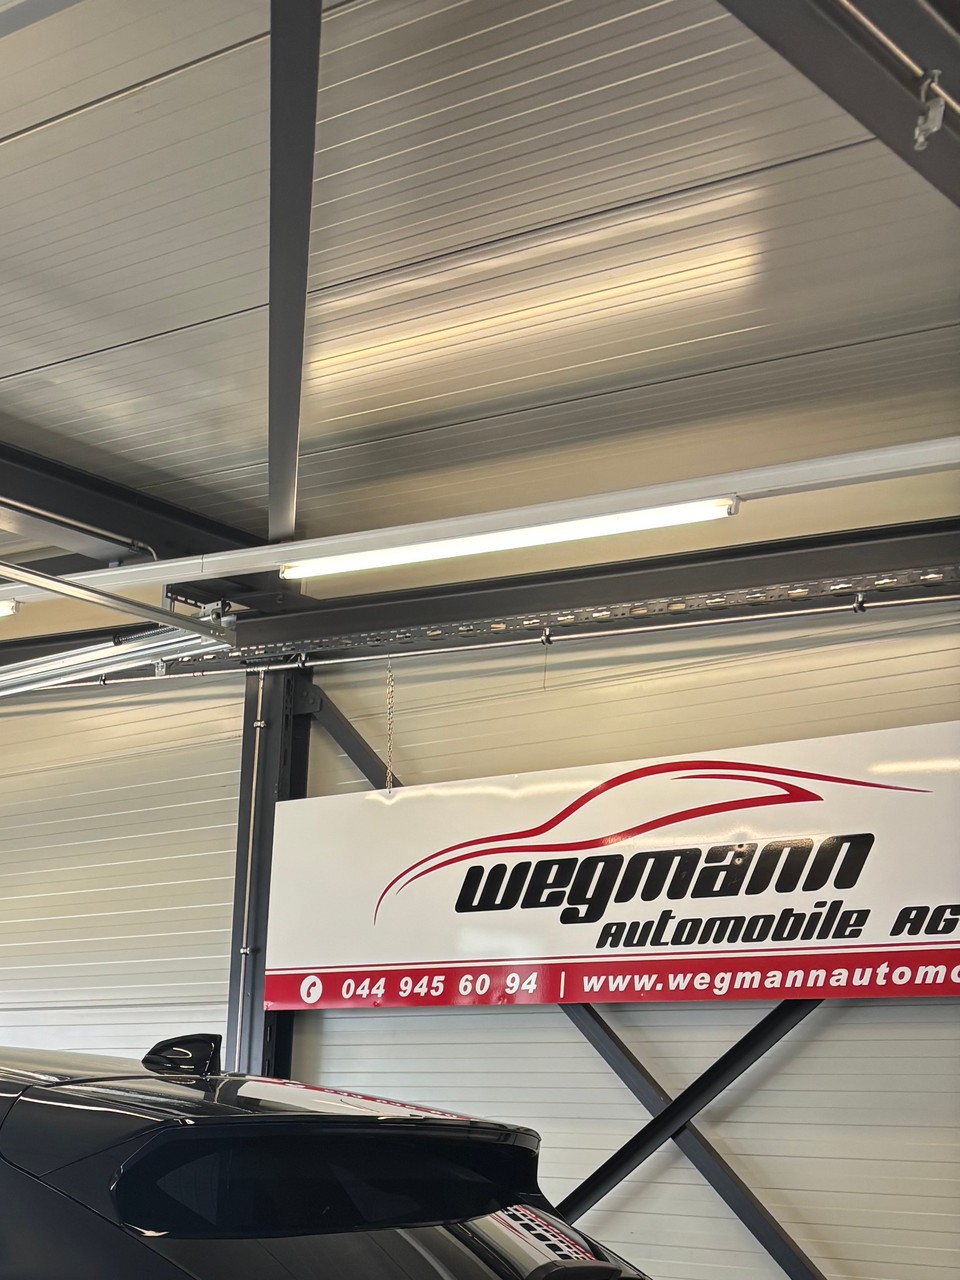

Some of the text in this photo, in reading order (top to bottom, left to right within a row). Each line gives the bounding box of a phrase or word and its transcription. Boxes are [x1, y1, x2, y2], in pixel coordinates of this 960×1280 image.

[455, 833, 874, 924] wegmann
[596, 900, 960, 948] automobile AG
[341, 977, 386, 999] 044
[398, 975, 445, 997] 945
[458, 974, 490, 996] 60
[504, 972, 538, 995] 94
